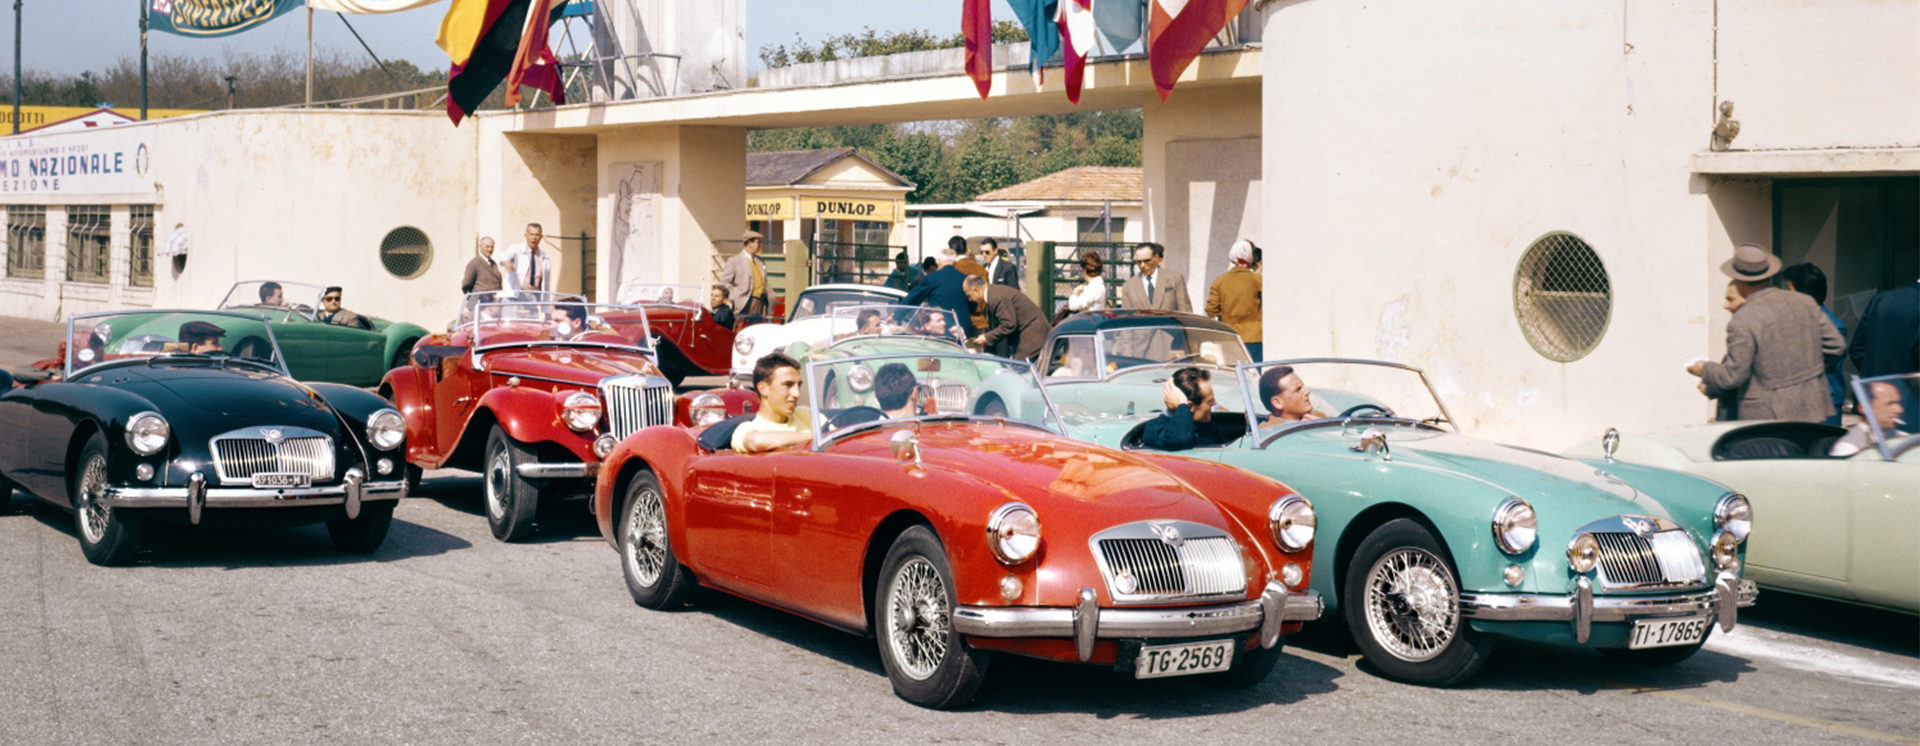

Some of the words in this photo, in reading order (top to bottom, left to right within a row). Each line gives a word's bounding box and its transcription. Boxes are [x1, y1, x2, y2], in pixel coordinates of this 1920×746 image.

[29, 152, 123, 177] NAZIONALE
[747, 203, 781, 215] DUNLOP
[817, 201, 876, 216] DUNLOP
